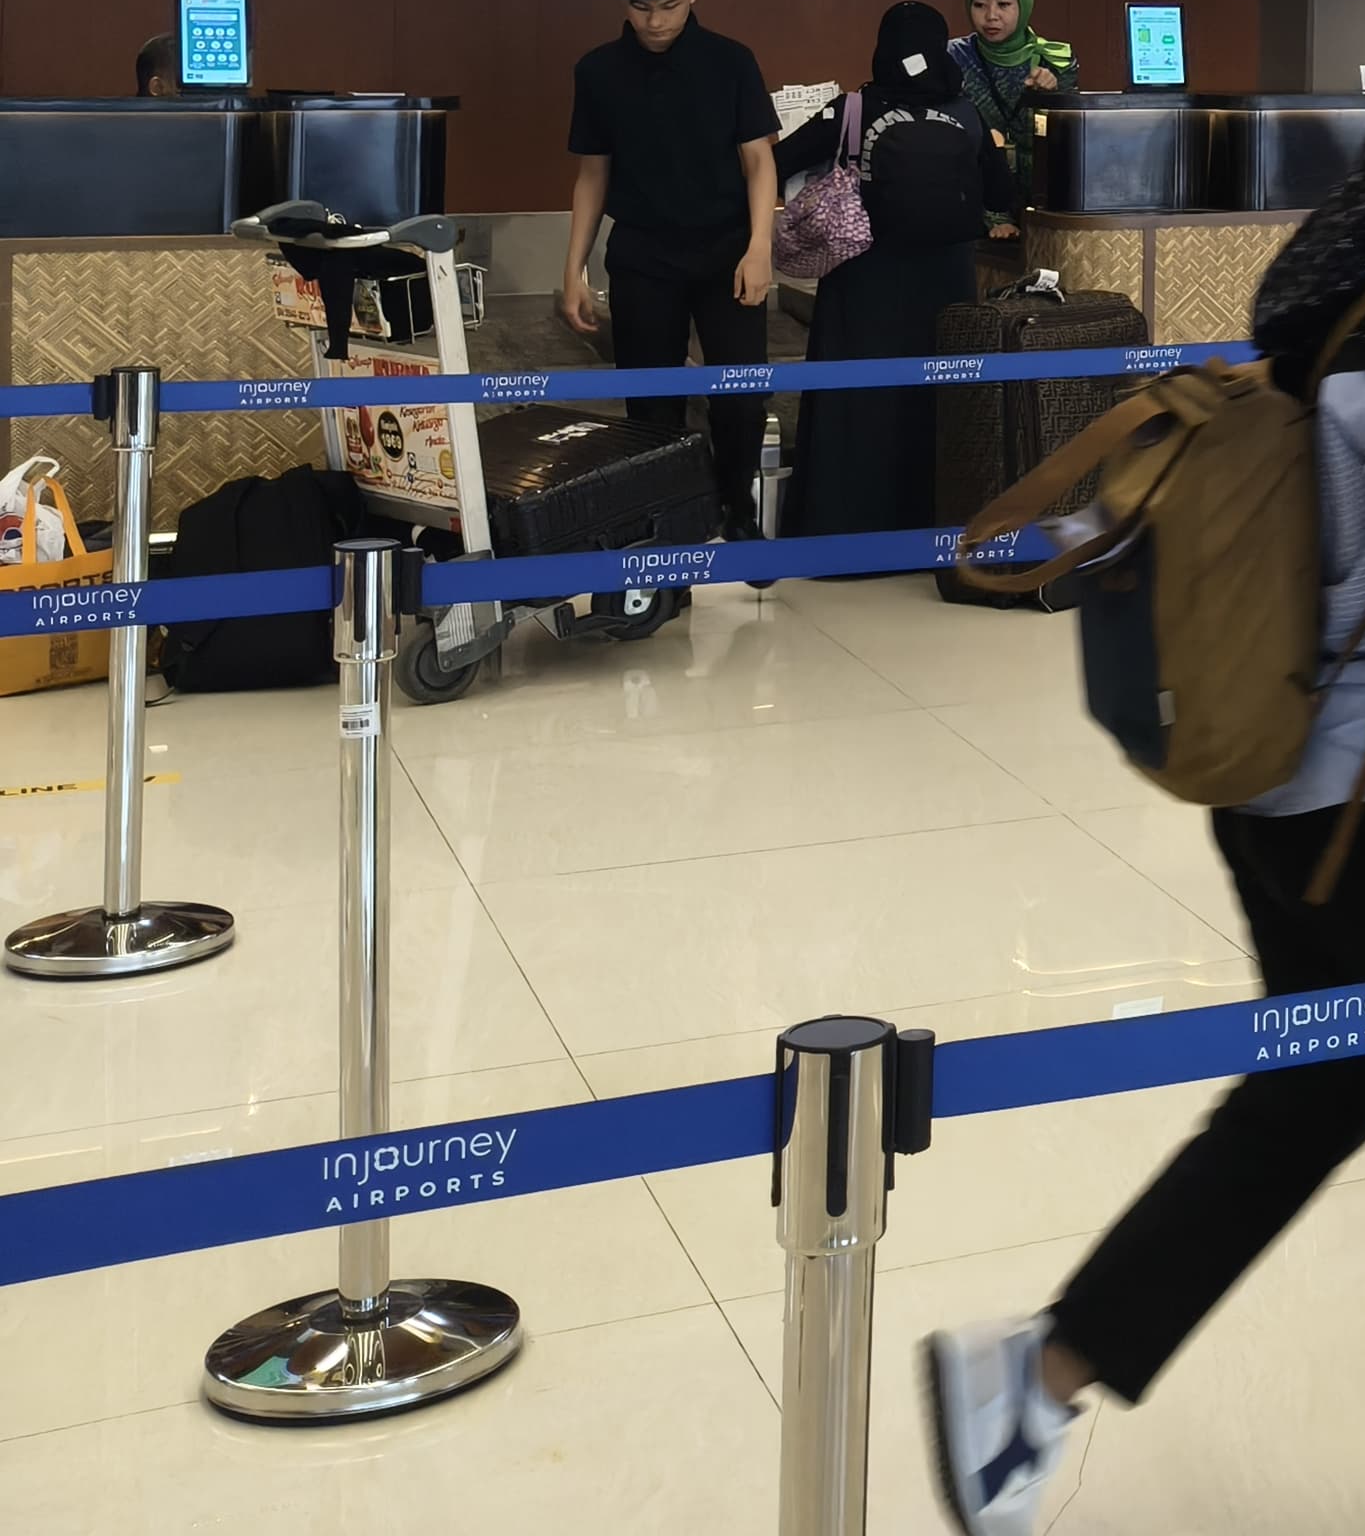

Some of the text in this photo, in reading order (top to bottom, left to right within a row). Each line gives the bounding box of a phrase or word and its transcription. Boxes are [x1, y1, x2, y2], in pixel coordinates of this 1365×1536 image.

[1125, 347, 1182, 362] injourney
[924, 358, 984, 374] injourney
[239, 381, 311, 397] injourney
[481, 375, 549, 390] injourney
[622, 550, 716, 573] injourney
[624, 570, 711, 585] AIRPORTS
[33, 588, 142, 613] injourney
[35, 609, 136, 627] AIRPORTS
[323, 1128, 517, 1185] injourney
[326, 1171, 505, 1212] AIRPORTS
